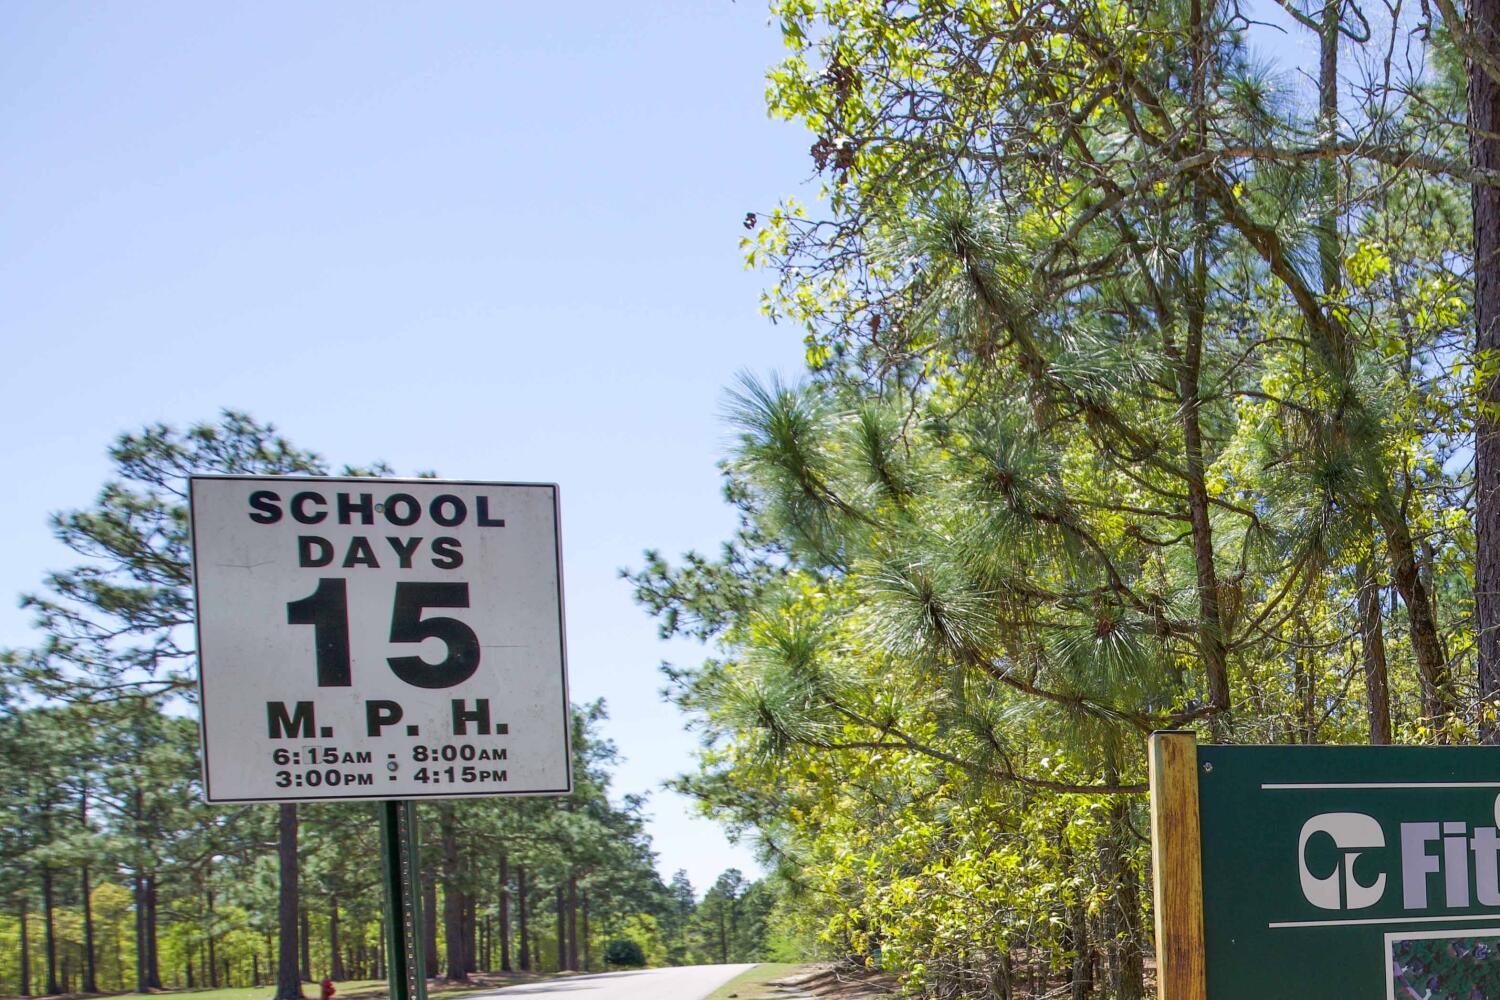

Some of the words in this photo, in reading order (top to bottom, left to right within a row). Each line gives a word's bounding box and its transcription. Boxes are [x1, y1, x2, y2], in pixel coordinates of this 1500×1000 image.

[248, 490, 505, 527] SCHOOL
[297, 535, 464, 569] DAYS
[286, 577, 481, 689] 15
[272, 746, 372, 765] 6:15AM
[412, 745, 508, 762] 8:00AM
[275, 768, 373, 787] 3:00PM
[413, 766, 508, 783] 4:15PM
